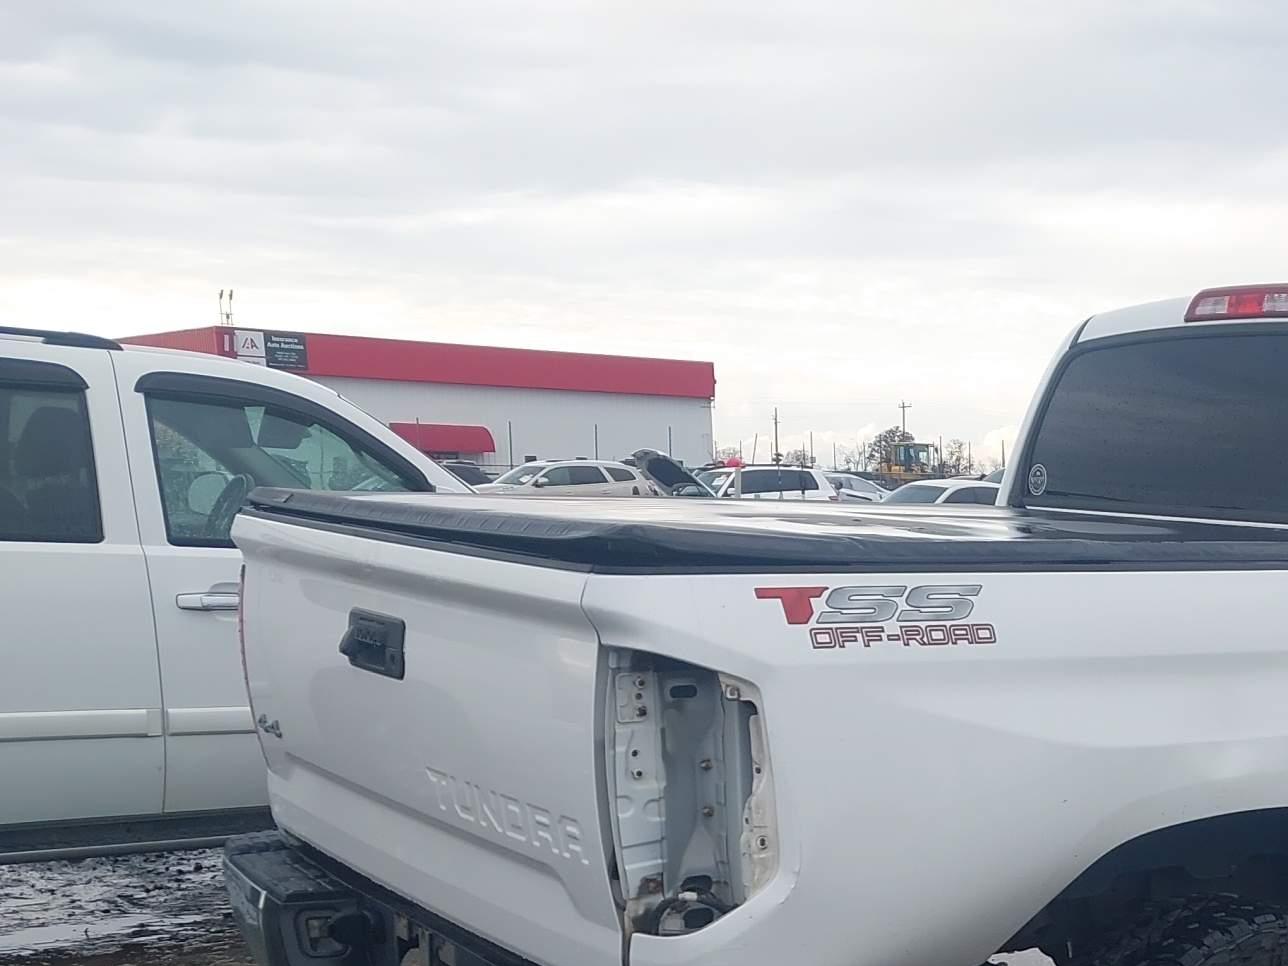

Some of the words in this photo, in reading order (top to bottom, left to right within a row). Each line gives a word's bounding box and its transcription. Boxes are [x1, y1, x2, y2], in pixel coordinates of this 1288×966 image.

[754, 584, 983, 625] TSS
[809, 623, 997, 649] OFF-ROAD
[425, 765, 590, 866] TUNDRA
